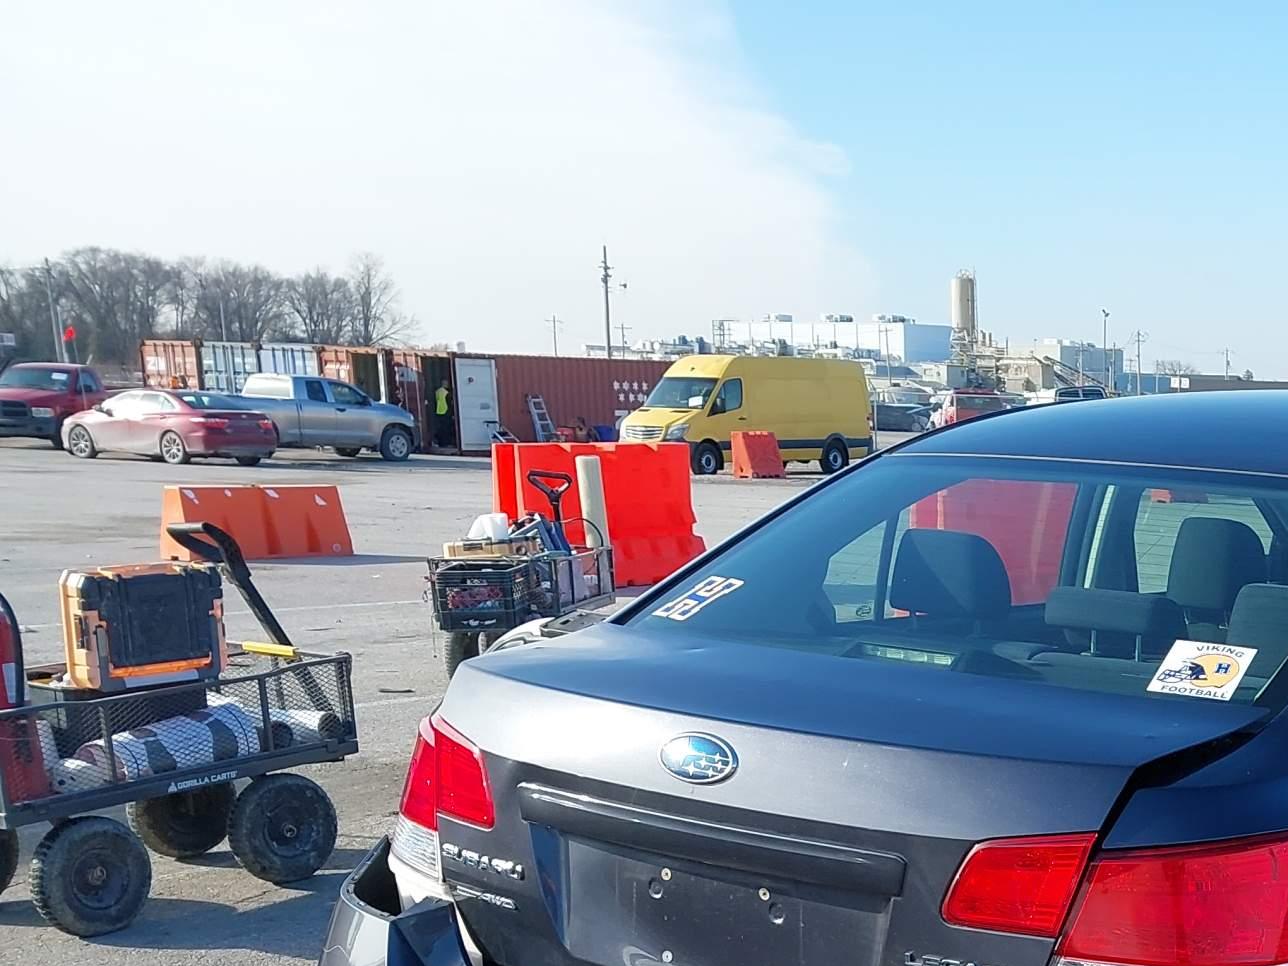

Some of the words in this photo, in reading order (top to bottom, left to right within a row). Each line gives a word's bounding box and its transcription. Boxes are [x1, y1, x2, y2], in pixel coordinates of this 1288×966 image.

[1197, 646, 1244, 658] VIKING
[1214, 663, 1231, 674] H
[1161, 686, 1227, 698] FOOTBALL
[177, 777, 209, 789] GORILLA
